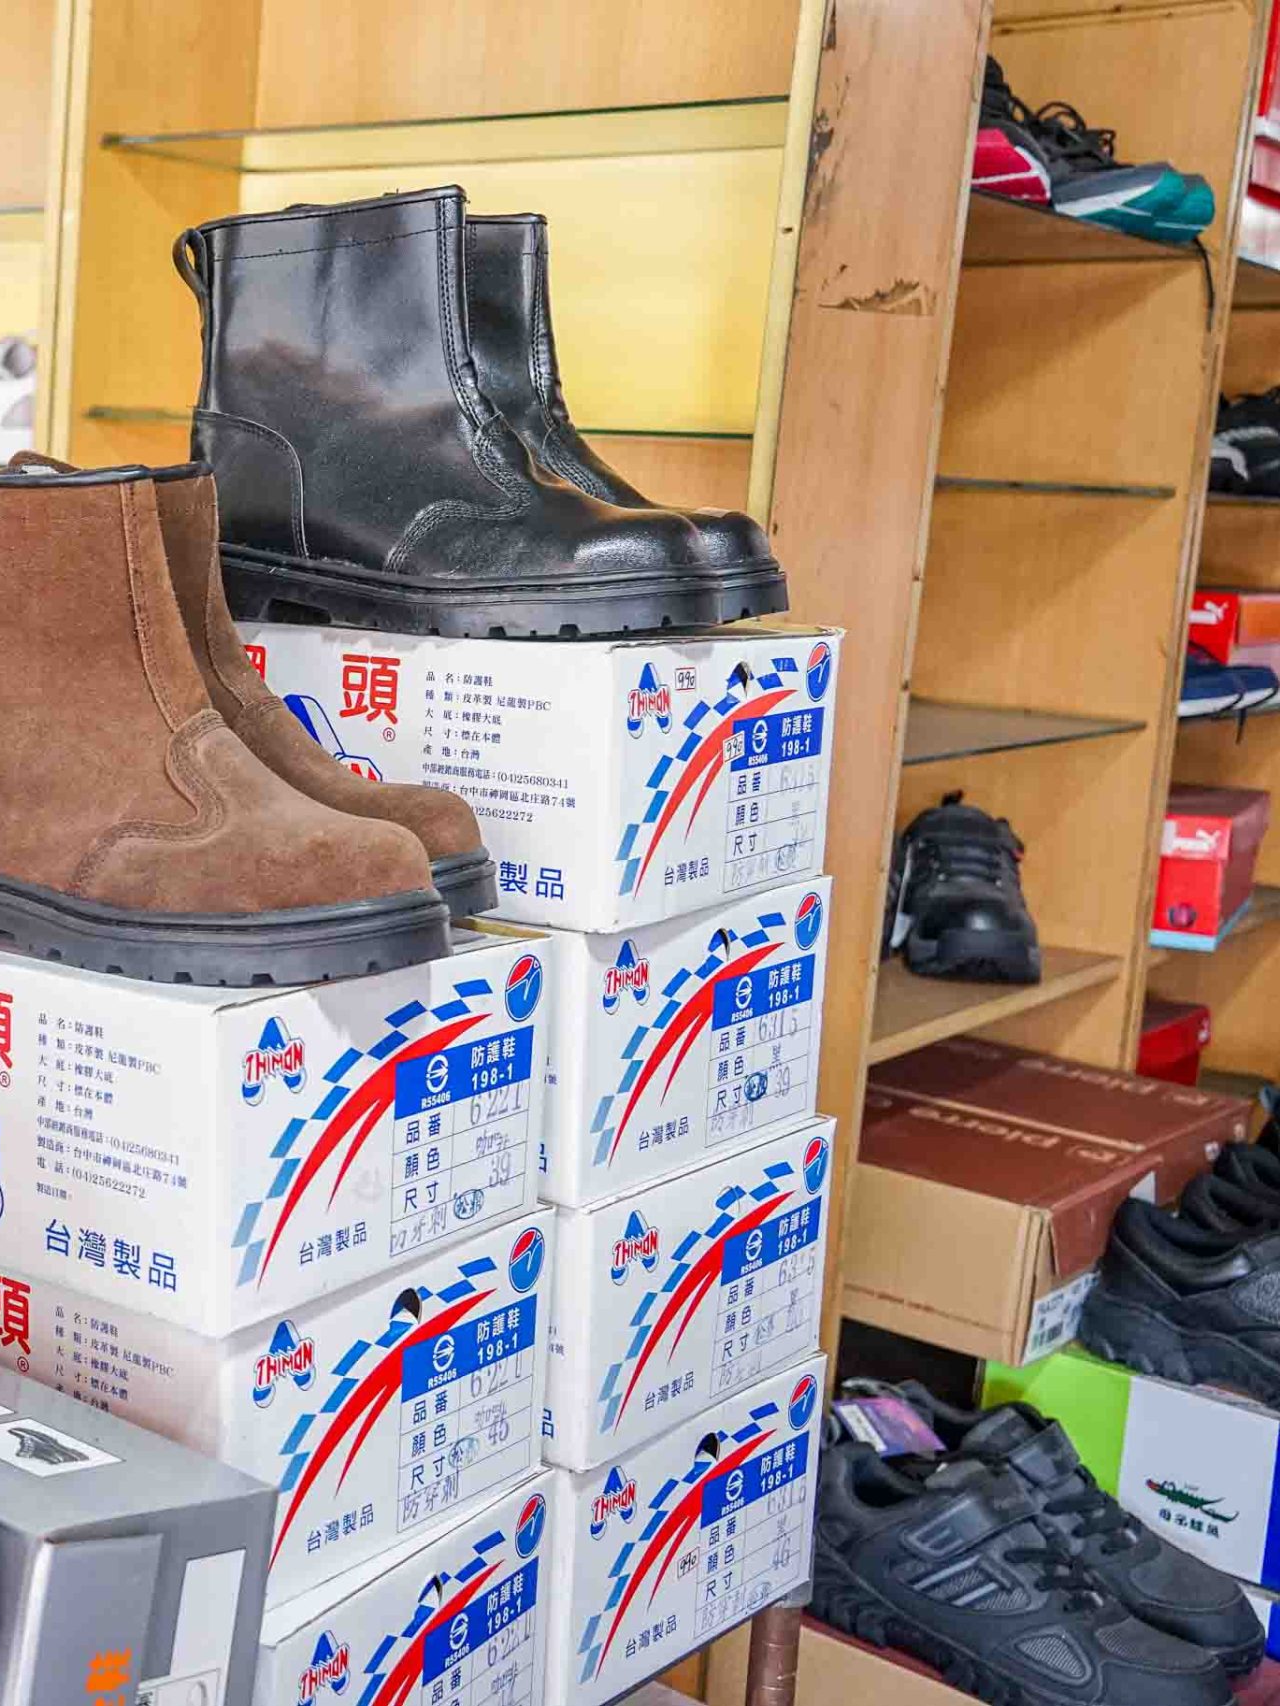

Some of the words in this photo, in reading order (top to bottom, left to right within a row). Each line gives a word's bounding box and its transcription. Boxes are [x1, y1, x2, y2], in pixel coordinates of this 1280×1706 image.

[340, 654, 401, 724] 頭
[678, 671, 695, 687] 990
[782, 714, 812, 737] 防護鞋
[727, 738, 743, 757] 990
[782, 740, 809, 757] 198-1
[733, 833, 757, 856] 尺寸
[606, 962, 649, 994] THIMON
[769, 963, 802, 990] 防護鞋
[769, 986, 800, 1008] 198-1
[471, 1037, 516, 1068] 防護鞋
[719, 1026, 746, 1053] 品番
[246, 1043, 303, 1083] THIMON
[471, 1067, 514, 1090] 198-1
[470, 1084, 521, 1126] 6221
[715, 1084, 742, 1112] 尺寸
[406, 1112, 441, 1144] 品番
[639, 1116, 689, 1152] 台灣製品
[404, 1180, 439, 1213] 尺寸
[778, 1207, 810, 1238] 防護鞋
[45, 1219, 177, 1292] 台灣製品
[299, 1221, 367, 1265] 台灣製品
[613, 1231, 657, 1267] THIMON
[778, 1232, 807, 1256] 198-1
[727, 1277, 755, 1306] 品番
[477, 1307, 520, 1342] 防護鞋
[478, 1333, 518, 1364] 198-1
[722, 1332, 749, 1362] 尺寸
[257, 1342, 313, 1388] THIMON
[471, 1351, 521, 1398] 6221
[413, 1390, 447, 1424] 品番
[645, 1371, 694, 1411] 台灣製品
[411, 1456, 445, 1490] 尺寸
[760, 1443, 796, 1477] 防護鞋
[760, 1468, 793, 1492] 198-1
[593, 1483, 636, 1522] THIMON
[307, 1503, 374, 1553] 台灣製品
[709, 1516, 736, 1546] 品番
[679, 1552, 697, 1576] 990
[487, 1572, 523, 1615] 防護鞋
[705, 1572, 733, 1600] 尺寸
[488, 1596, 521, 1634] 198-1
[625, 1614, 678, 1659] 台灣製品
[300, 1647, 347, 1702] THIMON
[432, 1666, 461, 1705] 品番
